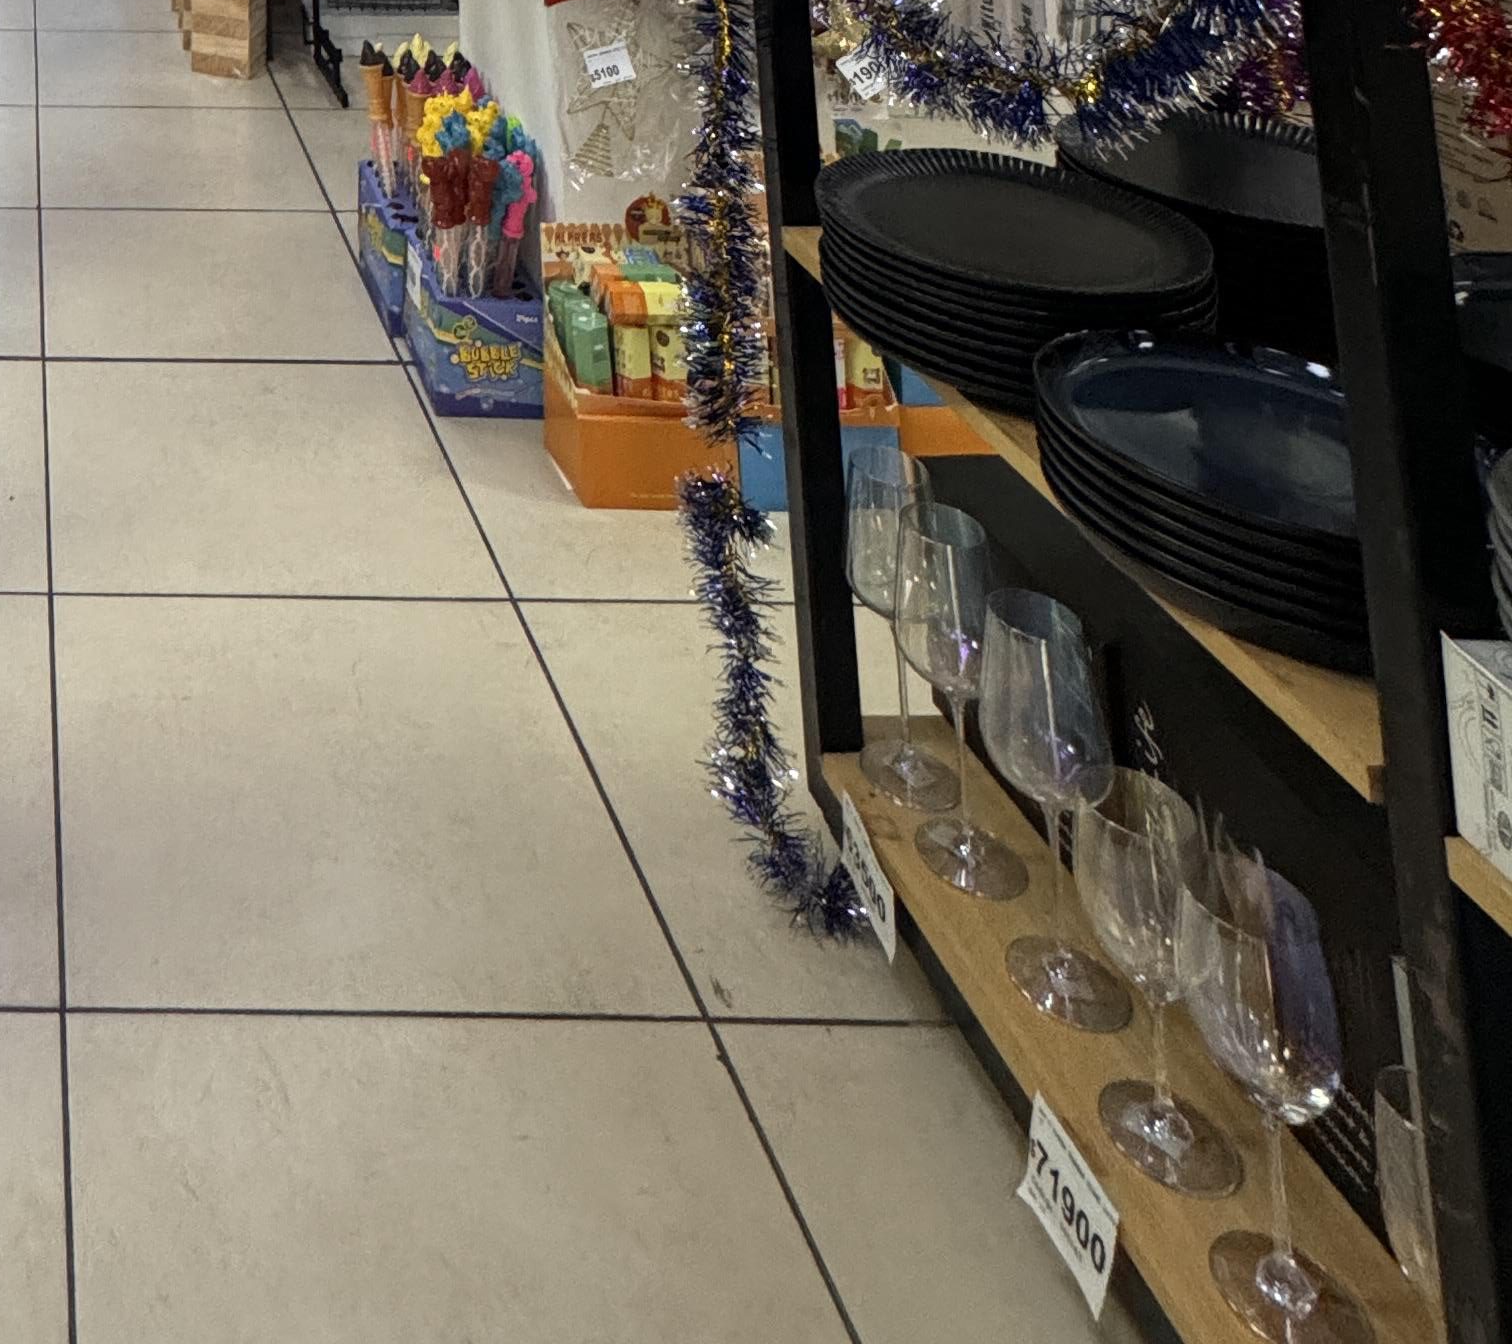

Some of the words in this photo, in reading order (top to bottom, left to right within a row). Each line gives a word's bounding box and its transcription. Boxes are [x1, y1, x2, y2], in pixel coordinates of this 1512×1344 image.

[590, 64, 620, 83] $5100
[458, 343, 521, 362] BUBBLE
[466, 362, 518, 380] STICK
